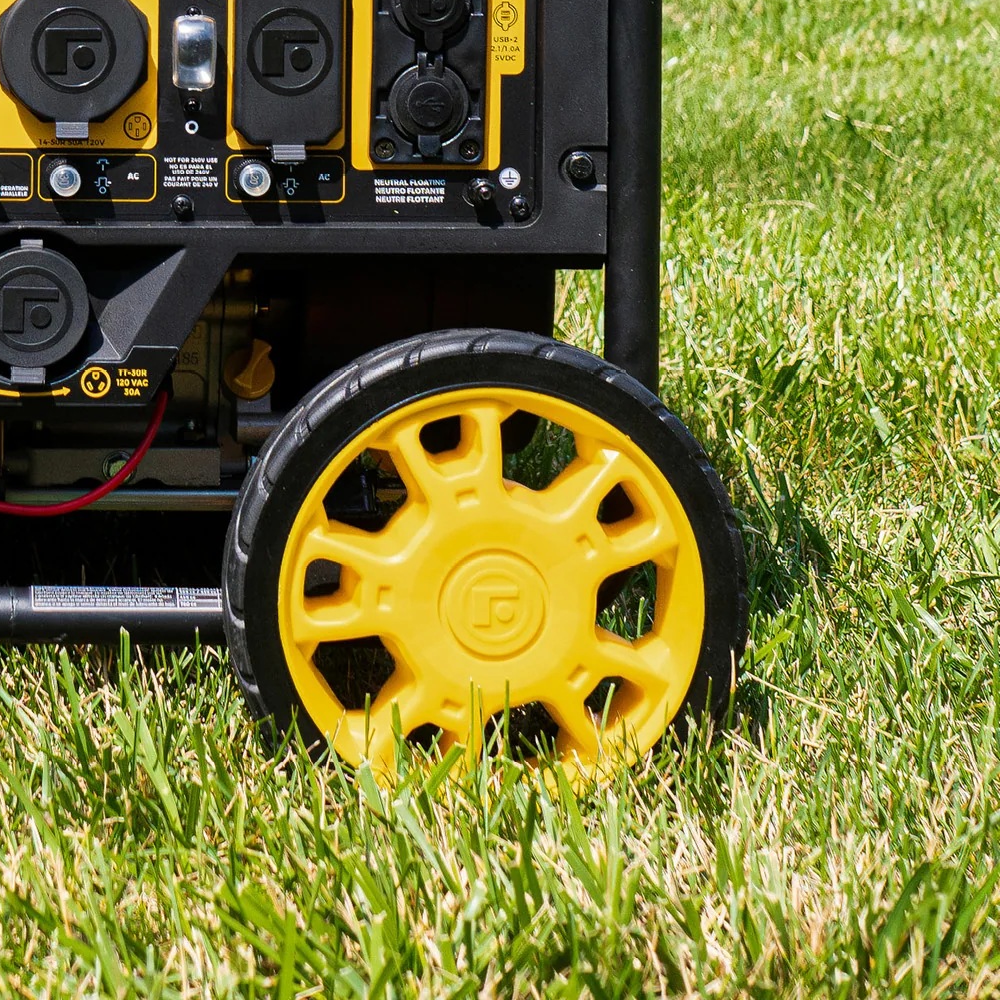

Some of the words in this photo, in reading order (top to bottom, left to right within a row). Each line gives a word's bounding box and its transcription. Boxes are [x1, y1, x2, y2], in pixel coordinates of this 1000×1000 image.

[118, 368, 147, 377] TT-30R
[116, 378, 130, 387] 120
[132, 378, 149, 387] VAC
[124, 388, 140, 396] 30A
